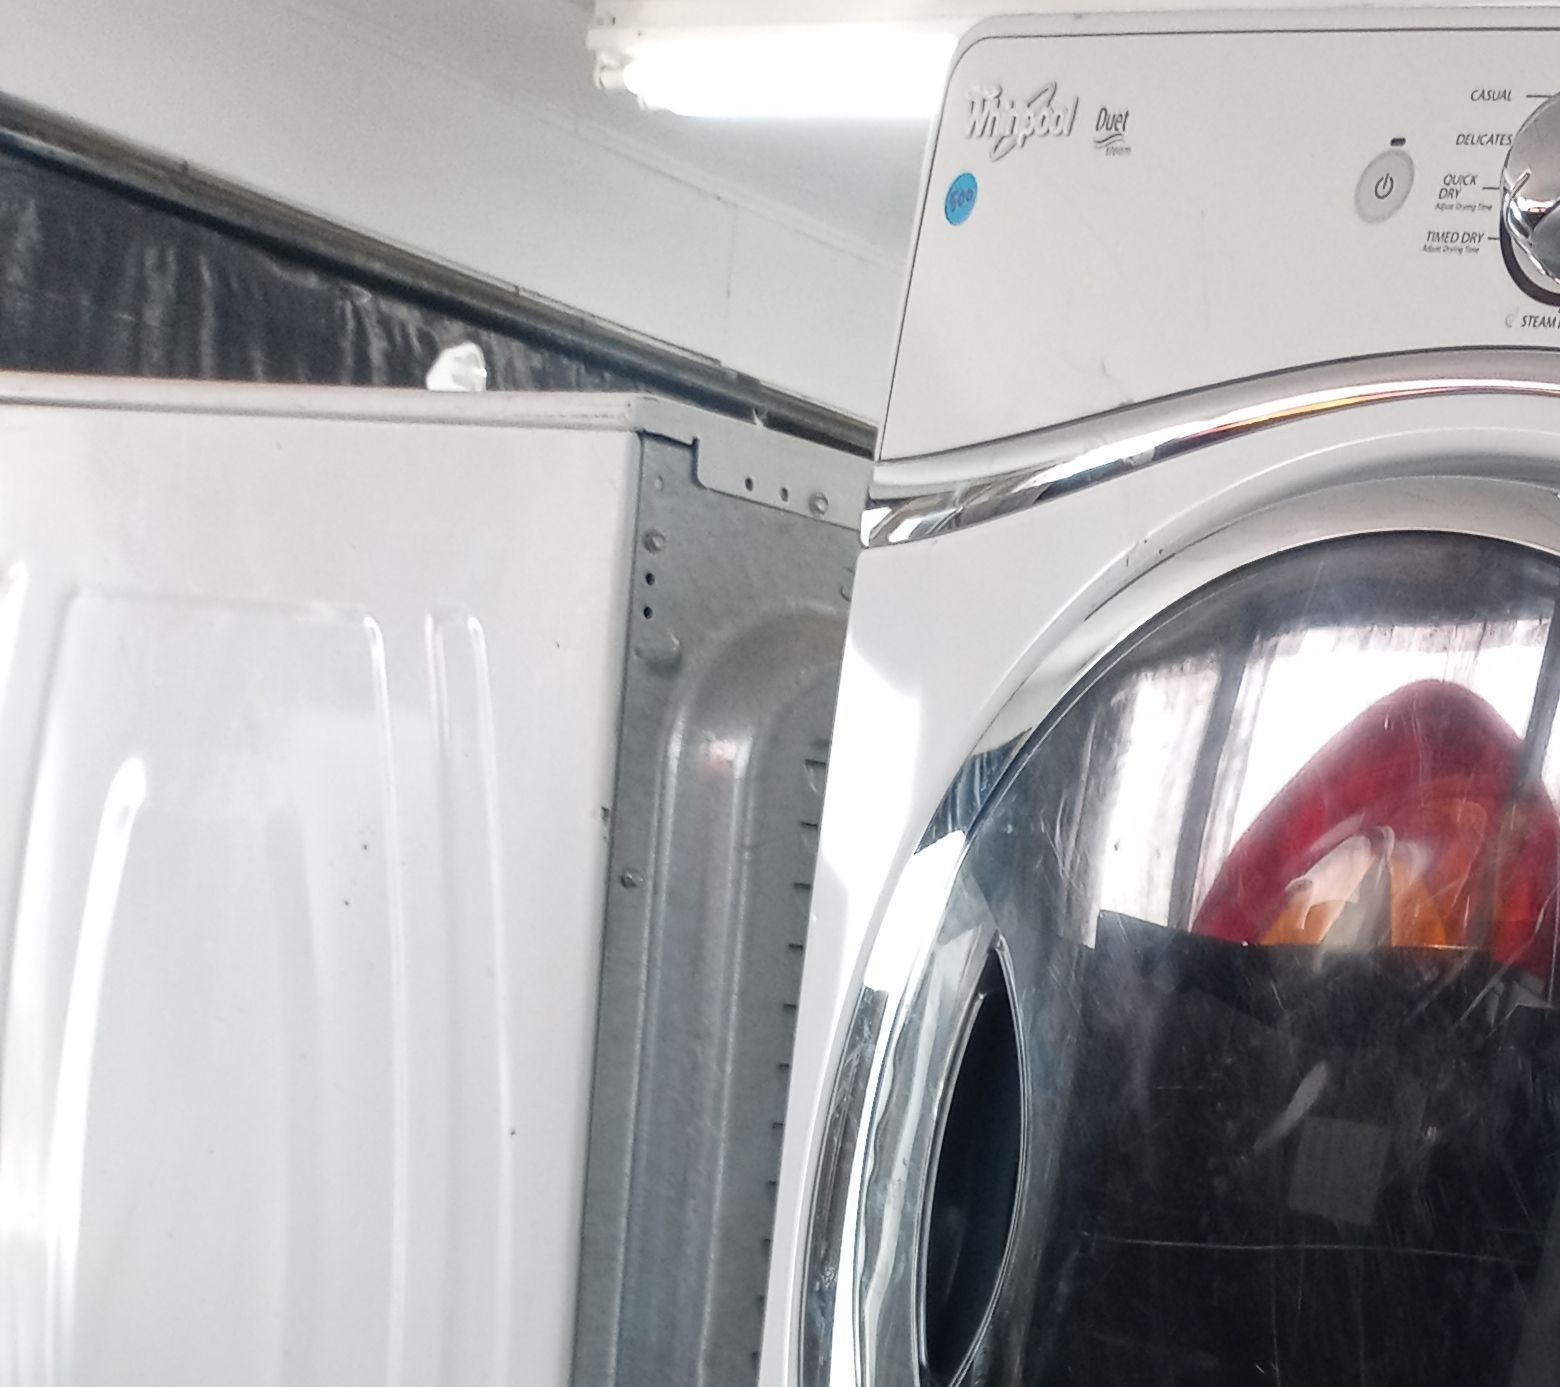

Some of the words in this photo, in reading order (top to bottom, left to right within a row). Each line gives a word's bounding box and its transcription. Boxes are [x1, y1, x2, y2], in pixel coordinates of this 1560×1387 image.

[1471, 90, 1512, 101] CASUAL
[966, 79, 1079, 162] Whirlpool
[1096, 107, 1129, 132] Duet
[1456, 134, 1513, 145] DELICATES
[1443, 174, 1477, 186] QUICK
[1439, 188, 1460, 199] DRY
[1426, 231, 1459, 243] TIMED
[1461, 232, 1484, 243] DRY
[1521, 315, 1555, 328] STEAM
